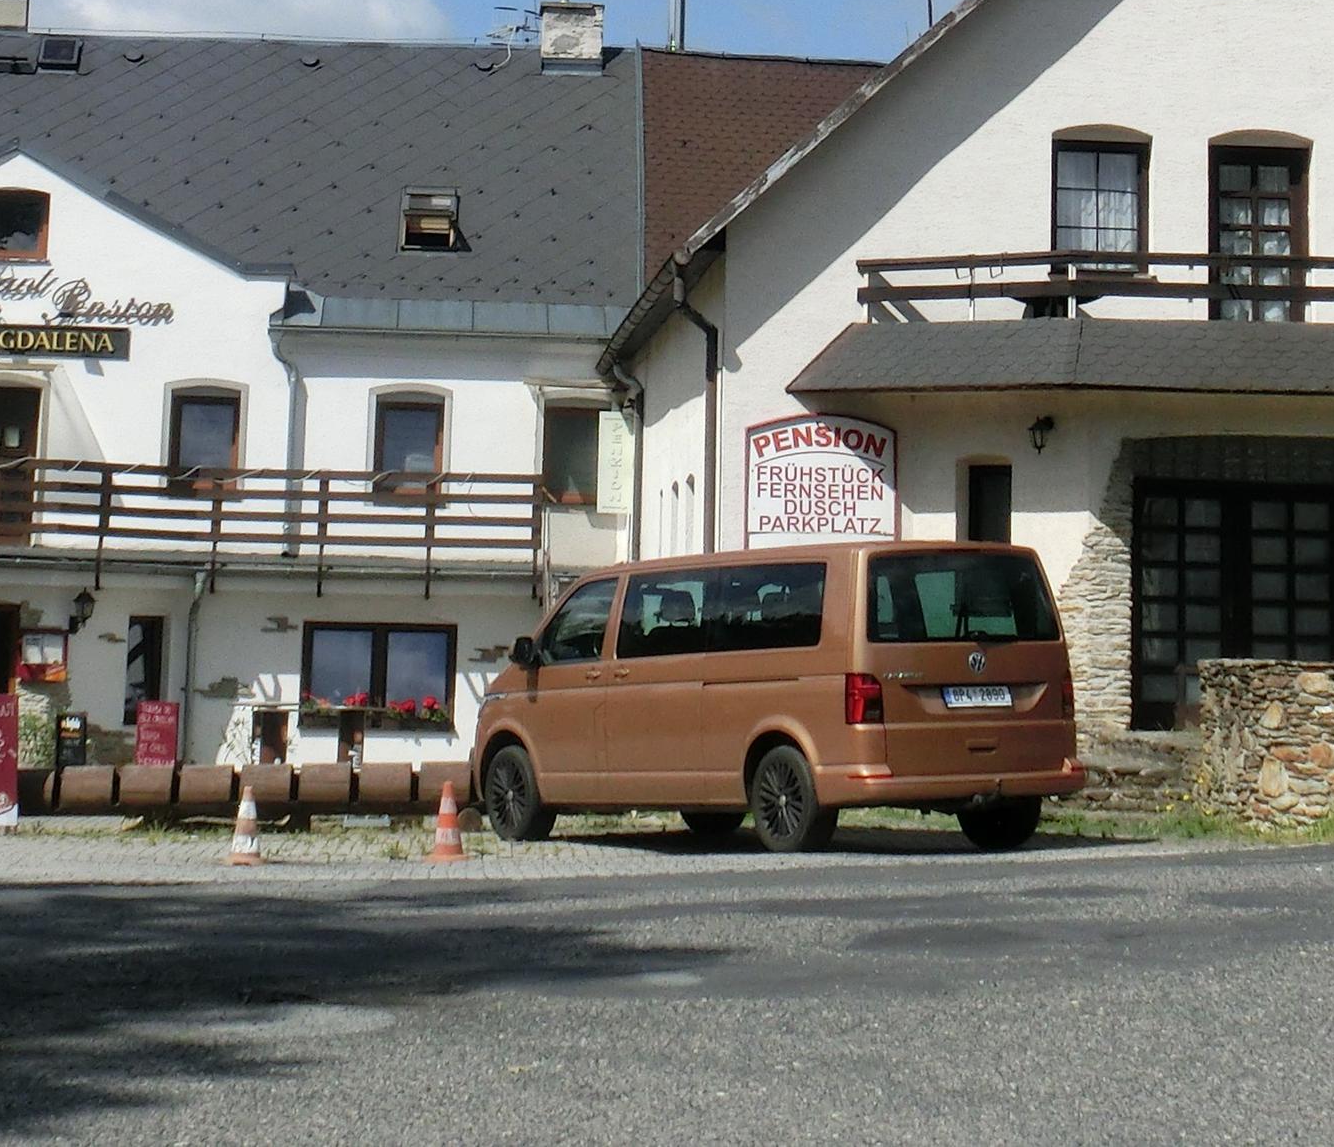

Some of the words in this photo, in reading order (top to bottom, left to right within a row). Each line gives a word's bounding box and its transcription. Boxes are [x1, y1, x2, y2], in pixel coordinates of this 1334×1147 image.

[753, 425, 887, 458] PENSION
[757, 463, 885, 483] FRÜHSTÜCK
[757, 482, 884, 501] FERNSEHEN
[784, 500, 856, 516] DUSCH
[759, 515, 882, 534] PARKPLATZ
